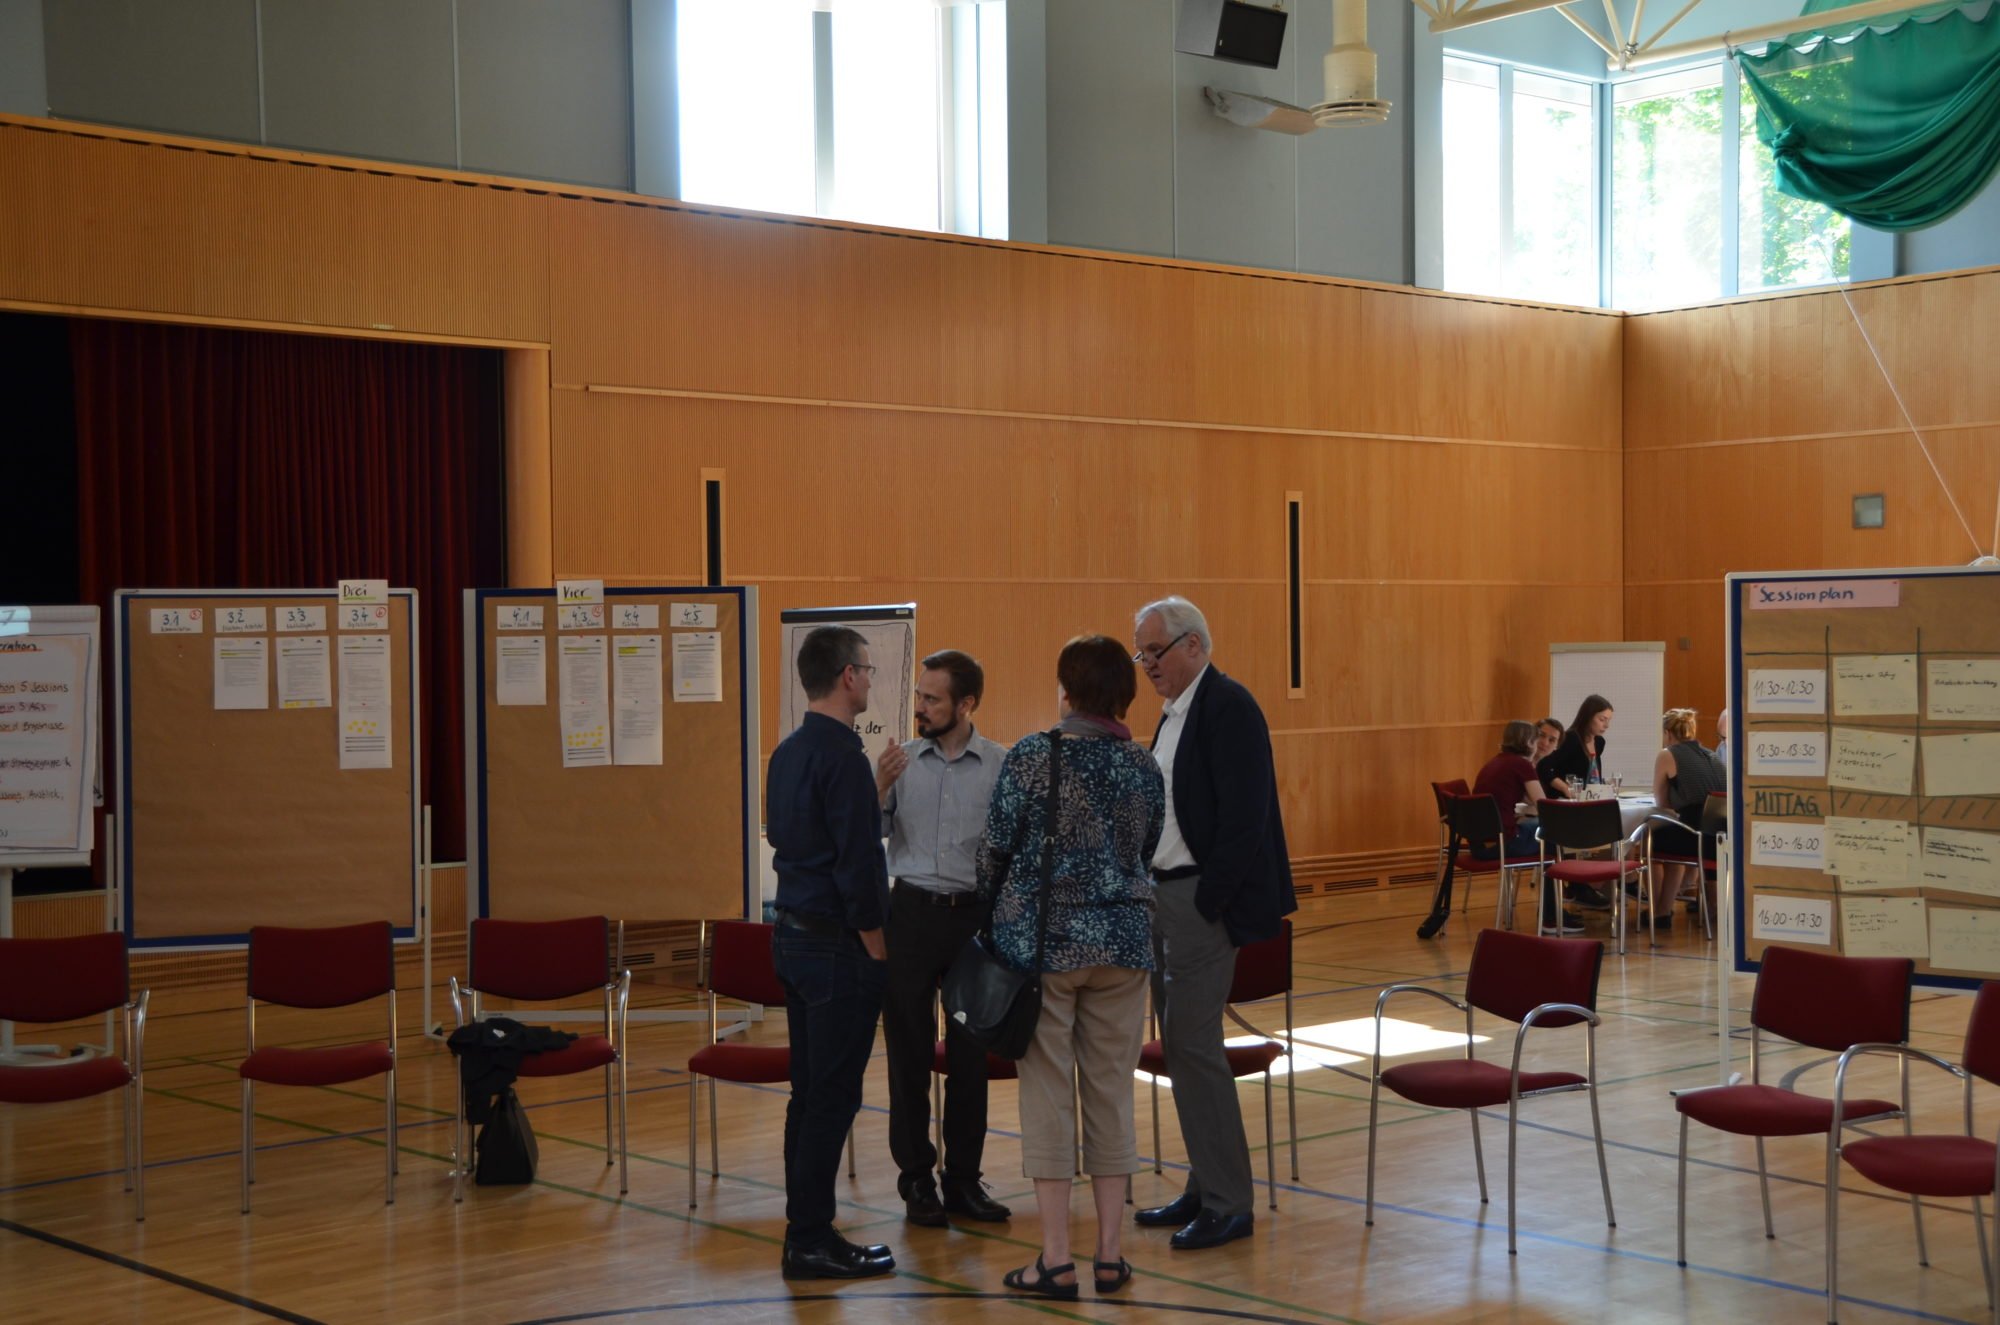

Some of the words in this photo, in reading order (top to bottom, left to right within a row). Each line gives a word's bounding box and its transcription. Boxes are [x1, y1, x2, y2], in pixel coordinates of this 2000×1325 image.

[343, 584, 368, 598] Drei
[563, 585, 591, 599] Vier
[162, 613, 180, 626] 3.1
[228, 611, 245, 624] 3.2
[865, 720, 887, 735] der
[1755, 791, 1820, 816] MITTAG
